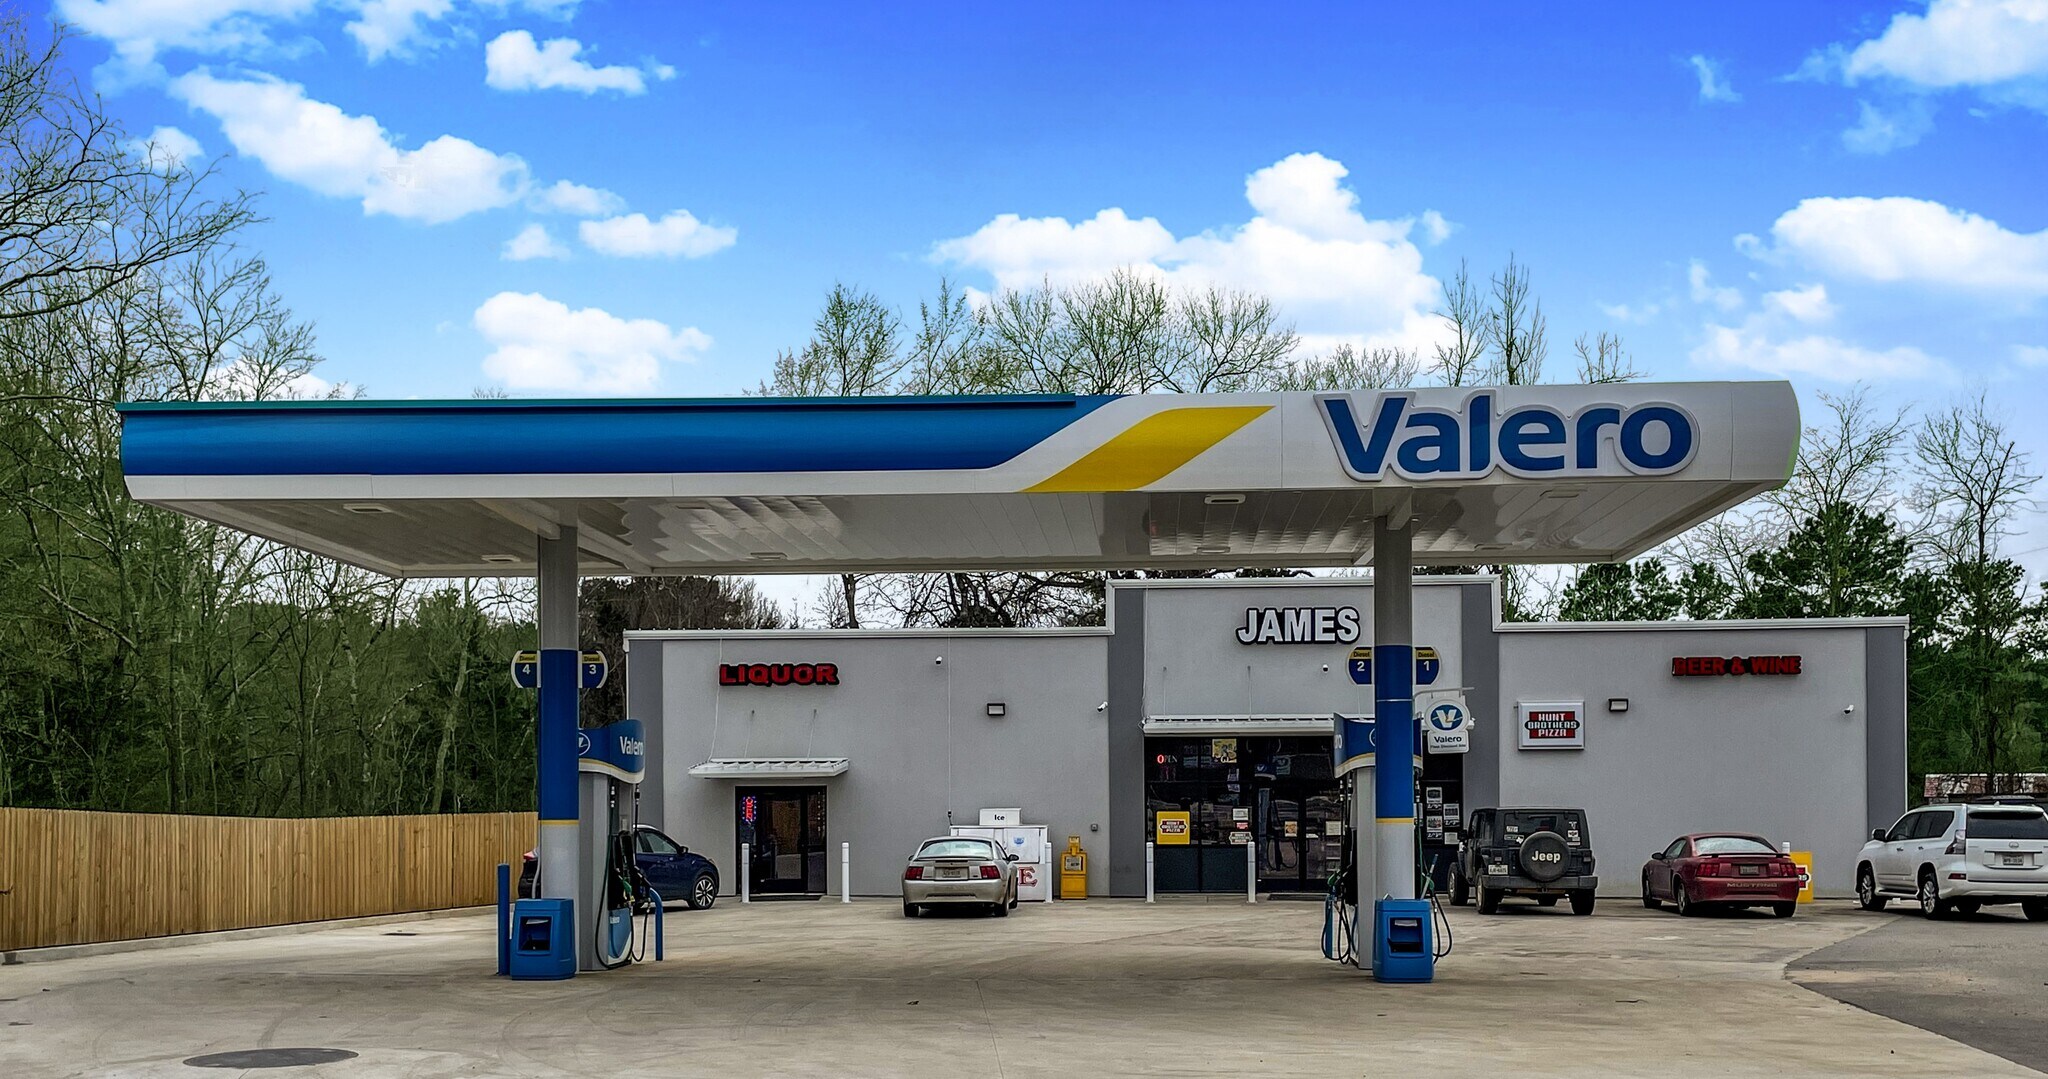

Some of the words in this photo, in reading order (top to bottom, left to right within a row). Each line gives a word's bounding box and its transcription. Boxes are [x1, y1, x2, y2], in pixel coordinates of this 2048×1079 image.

[1322, 394, 1692, 475] Valero
[1237, 607, 1360, 643] JAMES
[1353, 650, 1371, 658] Diesel
[1417, 650, 1436, 658] Diesel
[522, 664, 531, 675] 4
[588, 664, 597, 675] 3
[1357, 661, 1365, 672] 2
[1423, 660, 1430, 671] 1
[1673, 657, 1726, 675] BEER
[1731, 657, 1745, 675] &
[1748, 656, 1801, 675] WINE
[720, 663, 838, 686] LIQUOR
[1538, 713, 1566, 721] HUNT
[1527, 721, 1577, 729] BROTHERS
[1538, 729, 1567, 737] PIZZA
[1531, 850, 1561, 864] Jeep
